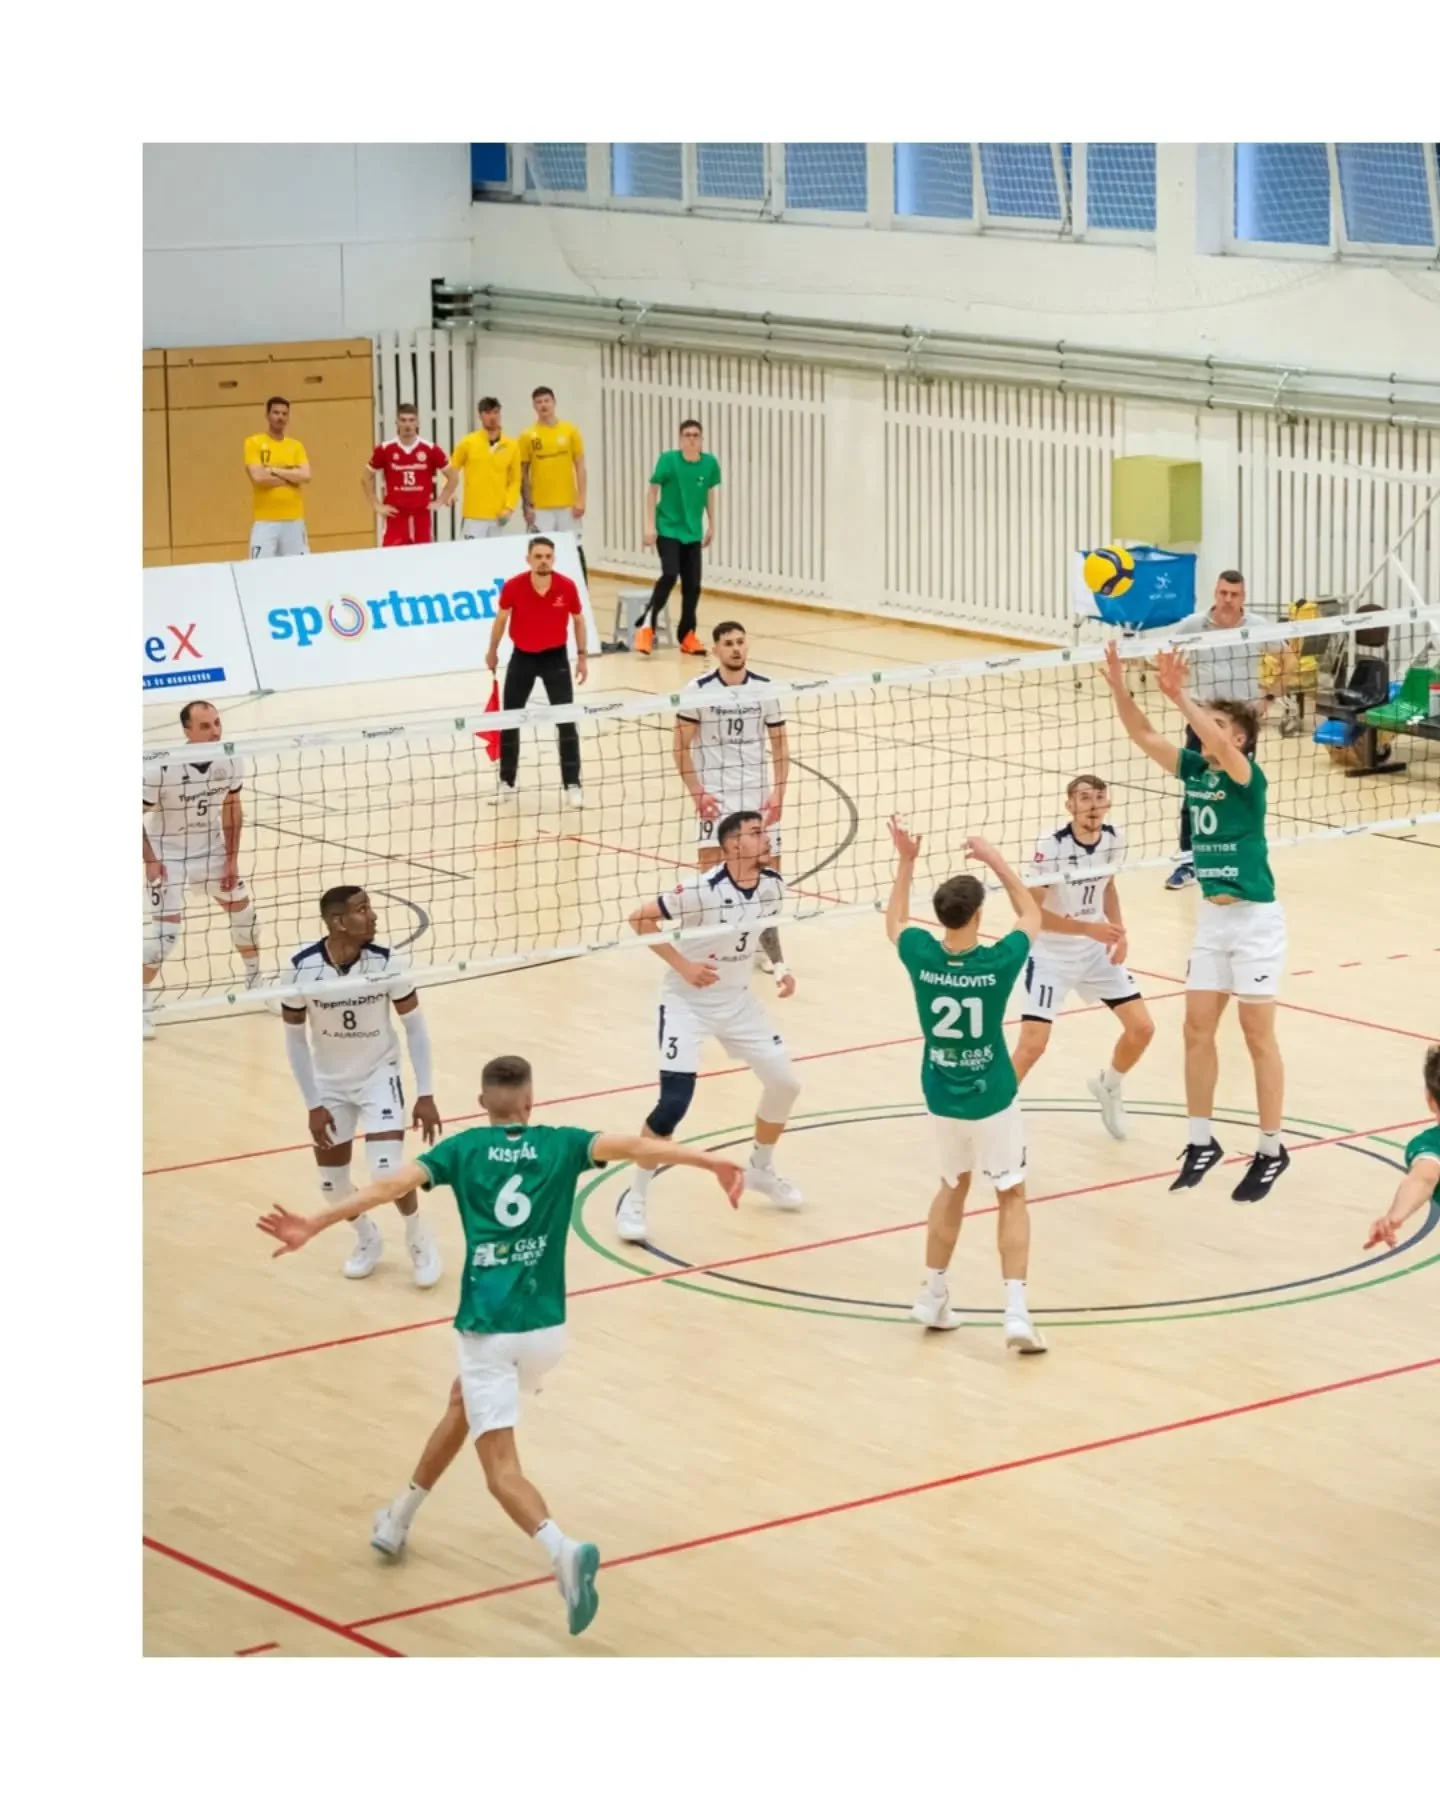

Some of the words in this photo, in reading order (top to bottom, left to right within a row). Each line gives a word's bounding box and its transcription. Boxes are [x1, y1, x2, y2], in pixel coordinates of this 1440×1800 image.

[403, 471, 416, 486] 13
[727, 718, 744, 736] 19
[196, 799, 208, 817] 5
[1190, 804, 1217, 836] 10
[151, 887, 161, 906] 5
[1083, 884, 1096, 906] 11
[735, 930, 750, 953] 3
[920, 968, 997, 988] MIHÁLOVITS
[1039, 983, 1053, 1009] 11
[342, 1009, 358, 1030] 8
[931, 995, 984, 1040] 21
[666, 1036, 679, 1061] 3
[493, 1173, 533, 1228] 6
